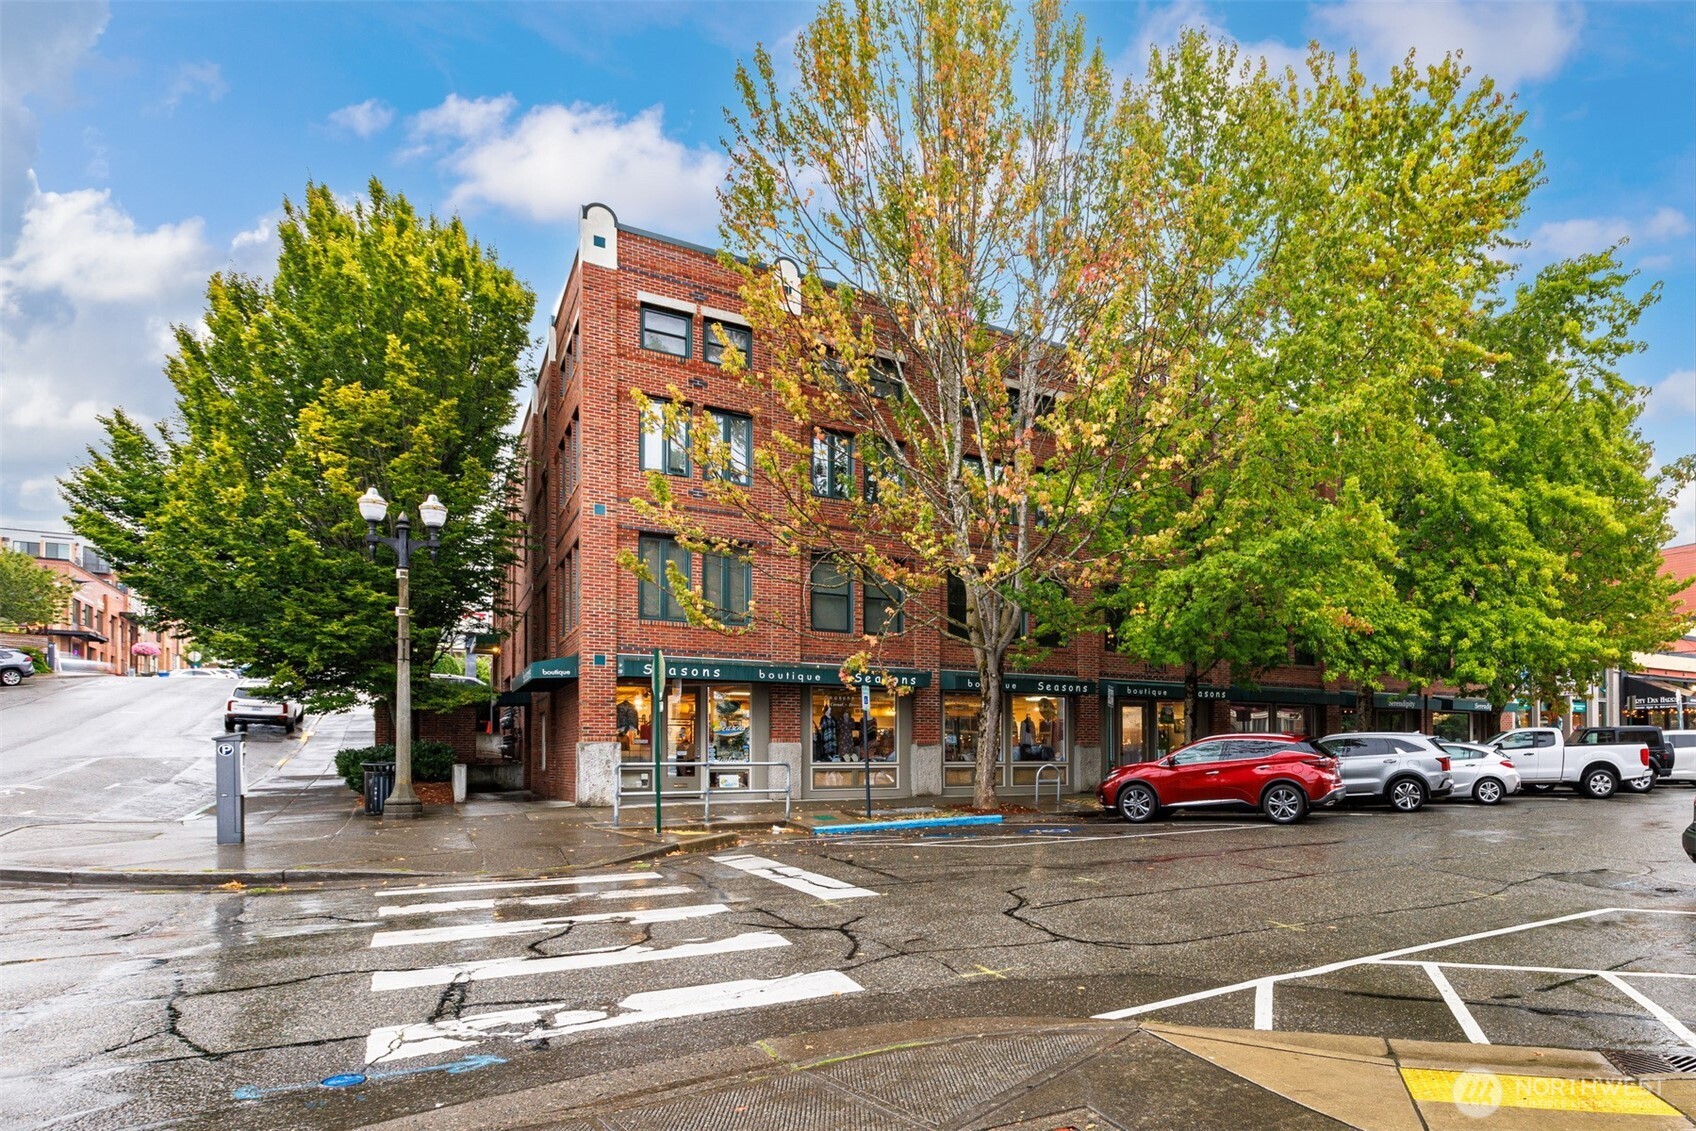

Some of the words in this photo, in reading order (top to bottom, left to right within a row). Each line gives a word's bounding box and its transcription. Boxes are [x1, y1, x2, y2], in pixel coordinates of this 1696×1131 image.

[541, 668, 571, 676] boutique
[643, 663, 721, 677] Sasons
[758, 669, 821, 683] boutique
[855, 672, 917, 685] Seaons
[967, 678, 1017, 690] boue
[1037, 681, 1088, 693] Seasons
[1126, 686, 1168, 697] boutique
[1197, 690, 1227, 699] asons
